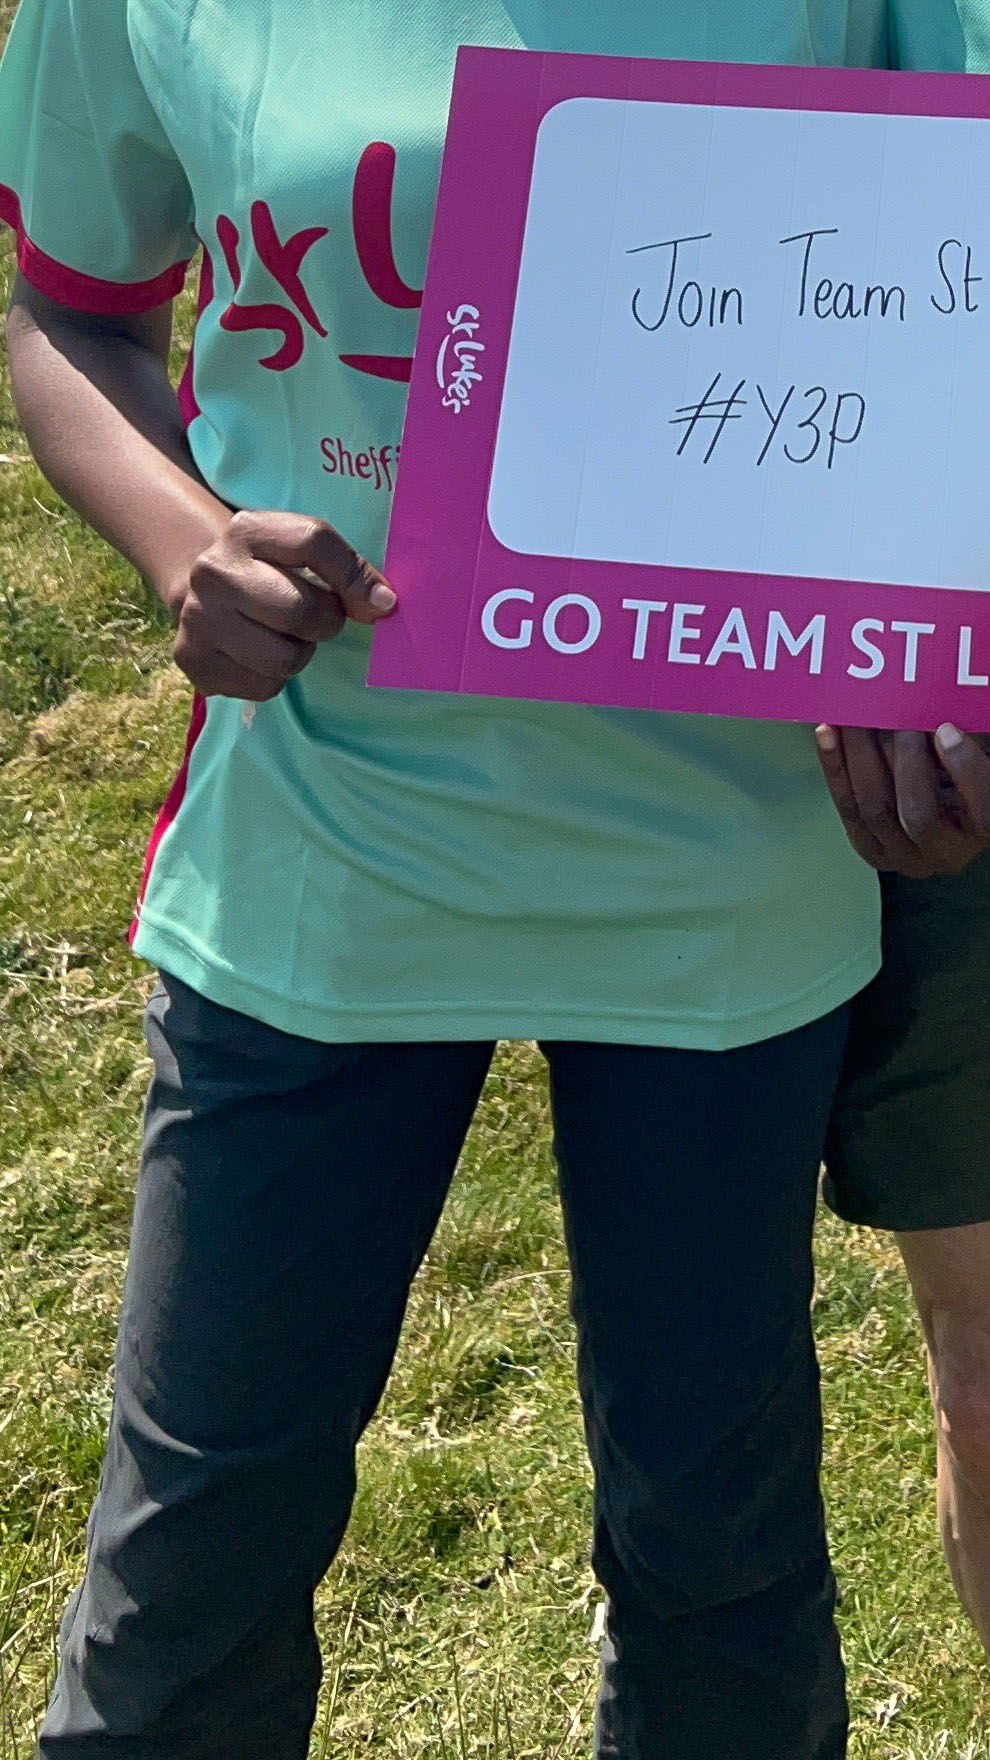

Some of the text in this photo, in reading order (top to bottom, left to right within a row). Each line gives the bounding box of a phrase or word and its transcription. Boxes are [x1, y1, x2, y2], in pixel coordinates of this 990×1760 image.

[625, 232, 743, 332] Join
[779, 228, 906, 323] Team
[930, 239, 984, 314] St
[446, 304, 480, 338] St
[320, 437, 401, 492] Sheff
[481, 588, 602, 655] GO
[622, 598, 826, 675] TEAM
[846, 617, 937, 682] ST
